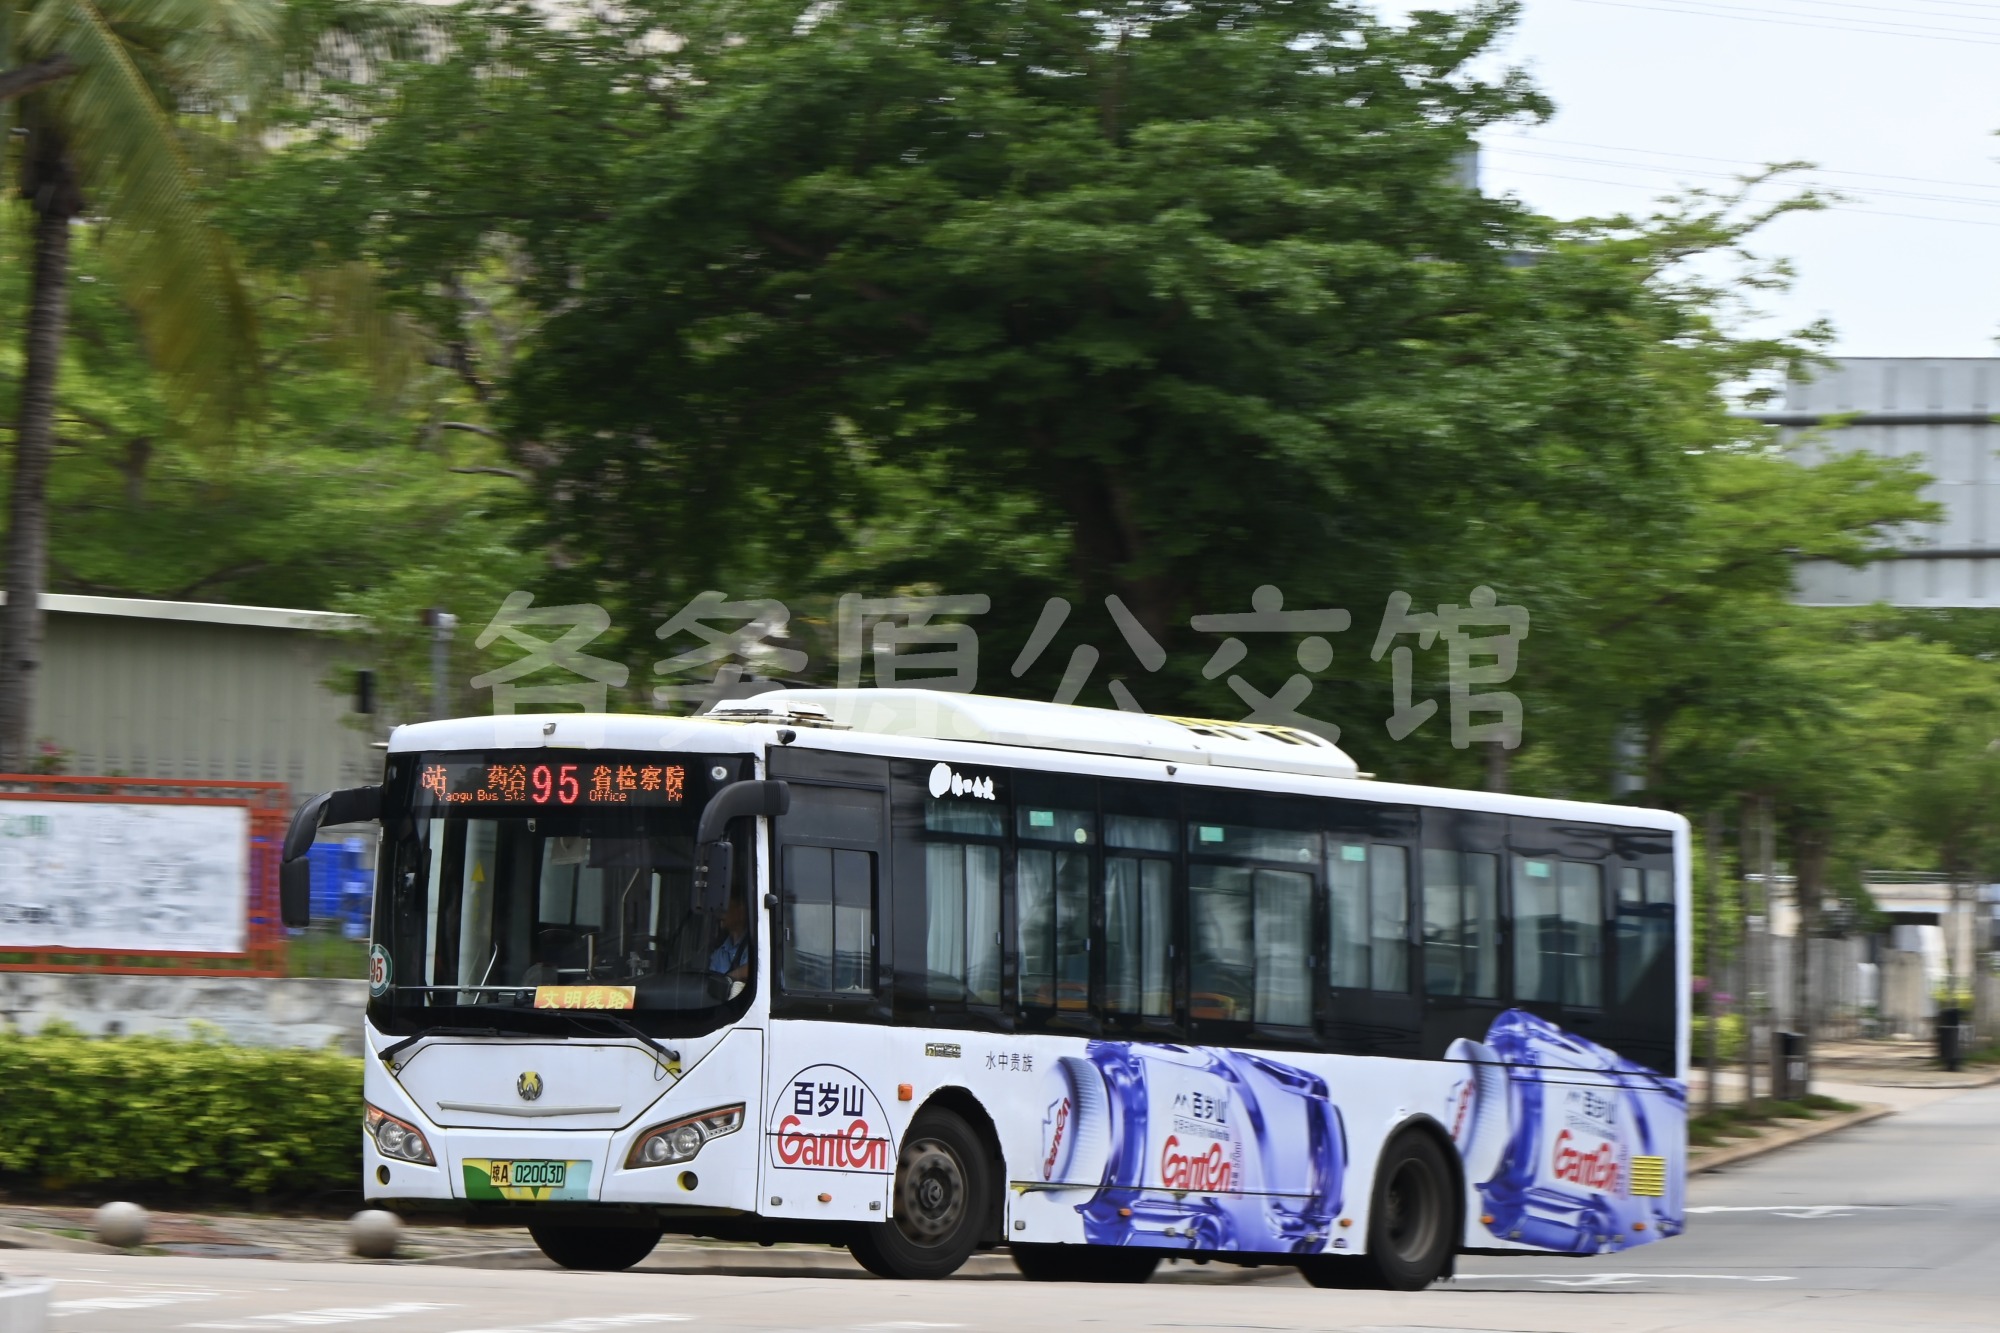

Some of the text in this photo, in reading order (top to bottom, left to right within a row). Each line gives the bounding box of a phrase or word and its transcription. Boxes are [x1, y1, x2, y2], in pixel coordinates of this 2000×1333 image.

[486, 765, 526, 791] 药谷
[532, 765, 579, 803] 95
[591, 765, 685, 791] 省检察院
[477, 789, 499, 801] Bus
[589, 789, 627, 802] Office
[370, 957, 383, 983] 95
[538, 989, 629, 1009] 文明线路
[986, 1050, 1033, 1072] 水中贵族
[794, 1082, 864, 1117] 百岁山
